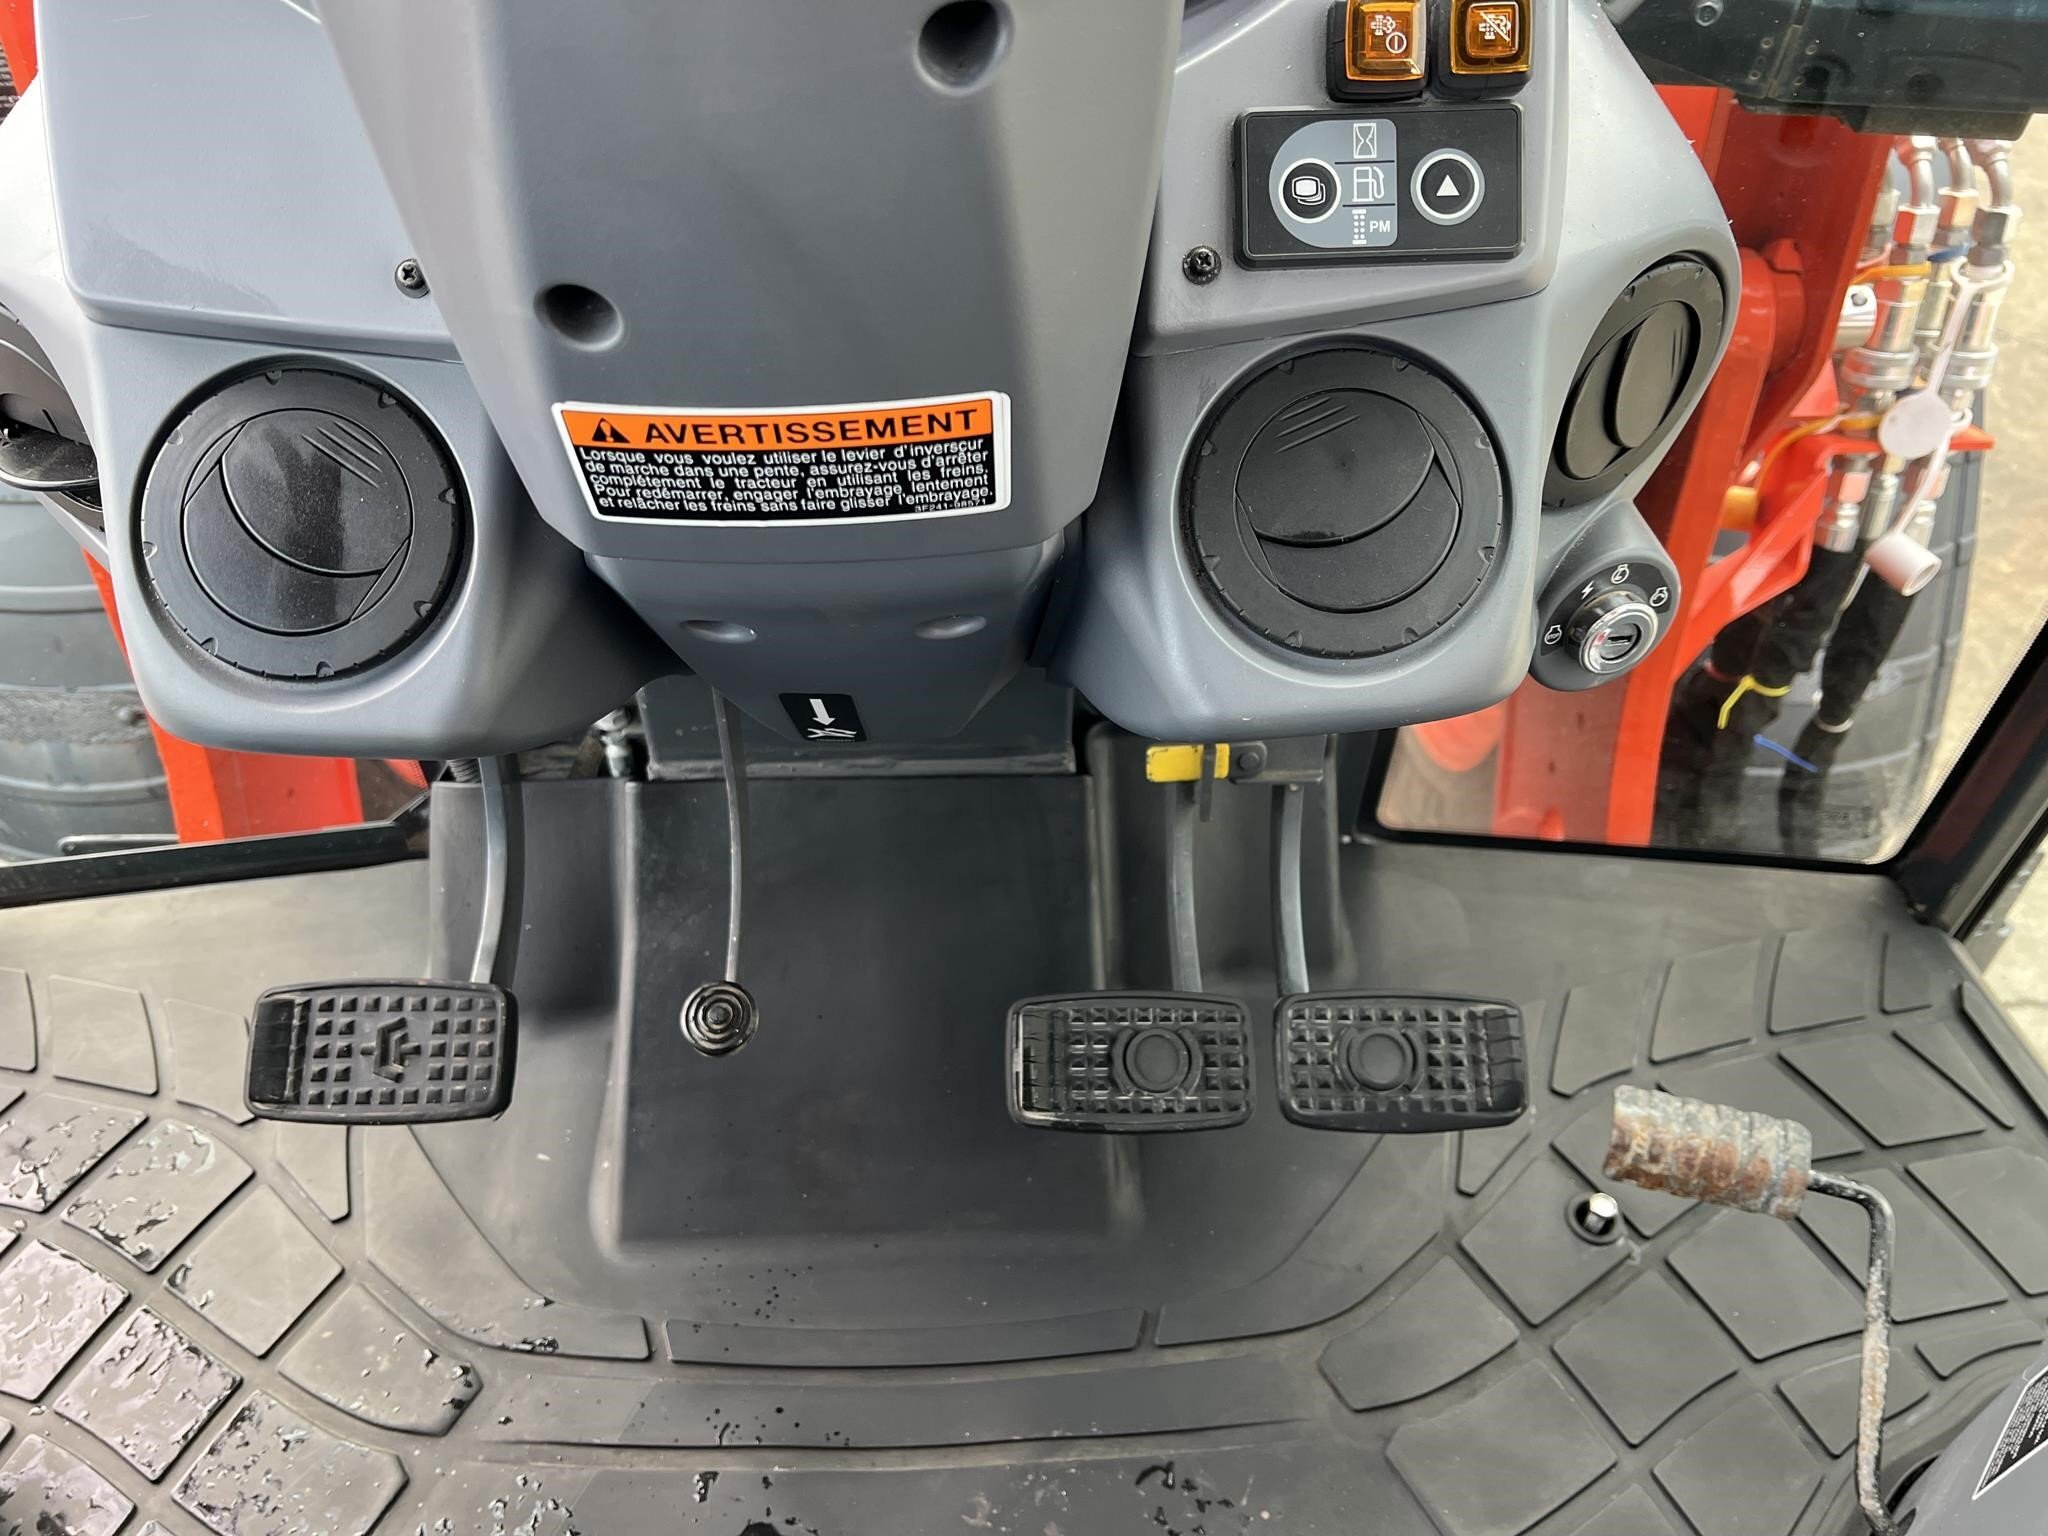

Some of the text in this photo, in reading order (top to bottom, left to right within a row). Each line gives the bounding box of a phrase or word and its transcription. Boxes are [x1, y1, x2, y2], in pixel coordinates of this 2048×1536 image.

[1369, 220, 1391, 233] PM
[644, 408, 978, 445] AVERTISSEMENT
[579, 446, 646, 464] Lorsque
[653, 453, 694, 465] vous
[701, 452, 756, 465] voulez
[763, 451, 817, 465] utiliser
[821, 449, 837, 463] le
[840, 447, 886, 462] levier
[585, 450, 989, 479] de marche dans une pente, assurez-vous d'arrêter
[590, 463, 989, 489] complétement le tracteur en utilisant les freins.
[593, 483, 631, 497] Pour
[636, 488, 729, 501] redémarrer,
[733, 490, 798, 503] engager
[911, 474, 988, 493] lentement
[599, 486, 993, 512] et relâcher les freins sans faire glisser l'embrayage.
